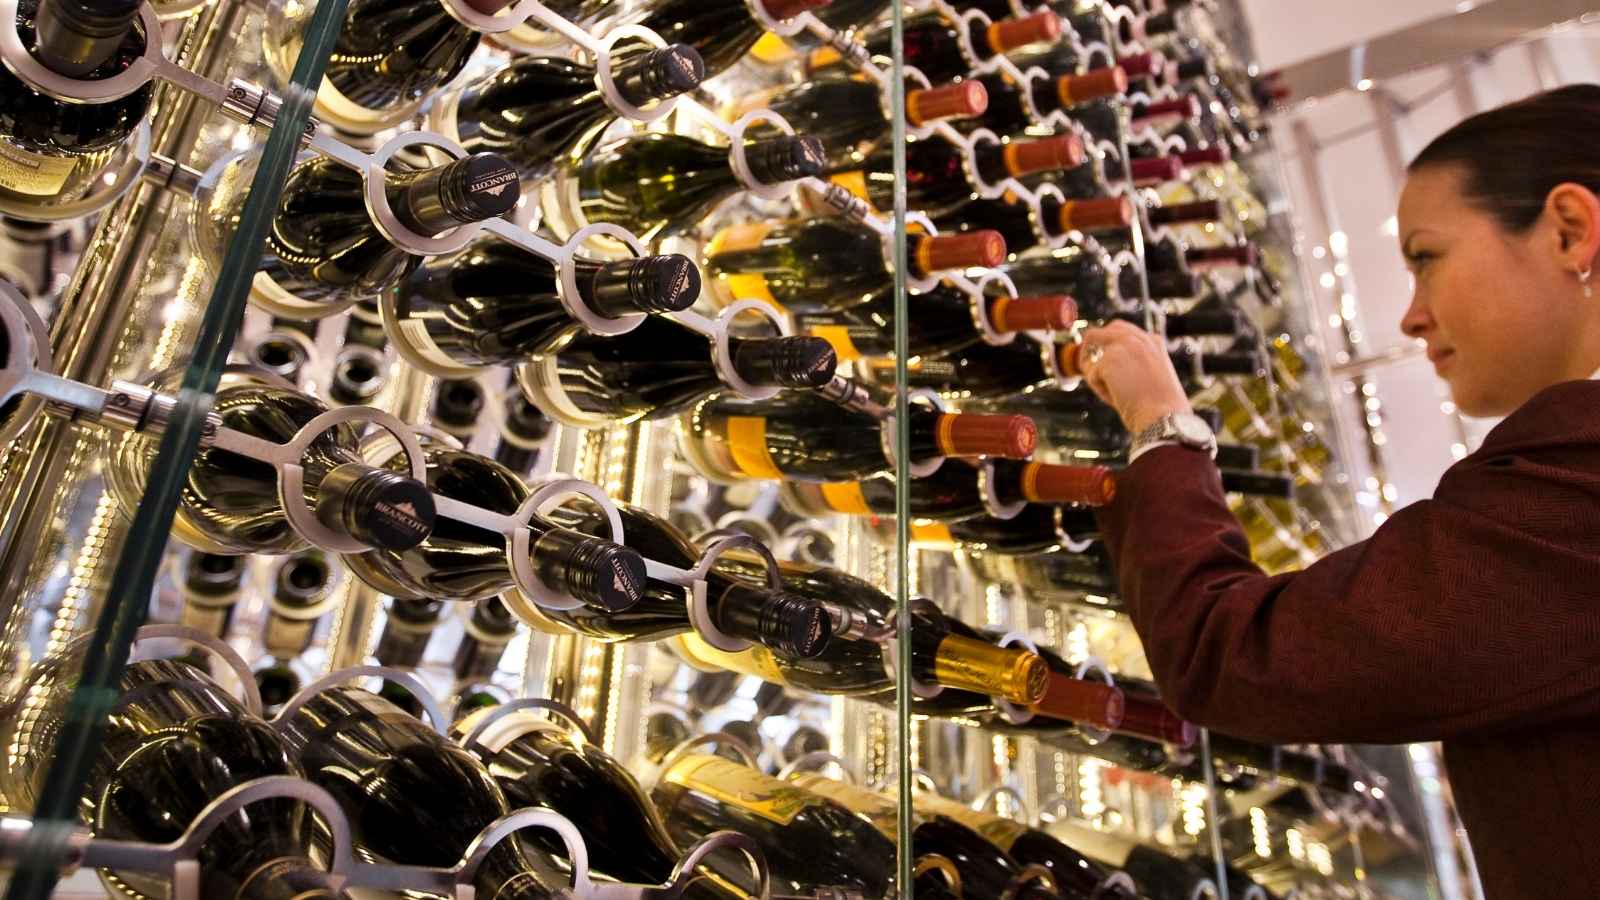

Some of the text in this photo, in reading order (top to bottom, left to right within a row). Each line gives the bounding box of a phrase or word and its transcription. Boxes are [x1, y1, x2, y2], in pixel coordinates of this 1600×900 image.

[471, 171, 517, 192] BRANCOTT
[669, 259, 689, 304] BRANCOTT
[374, 502, 430, 533] BRANCOTT
[611, 557, 638, 601] BRANCOTT
